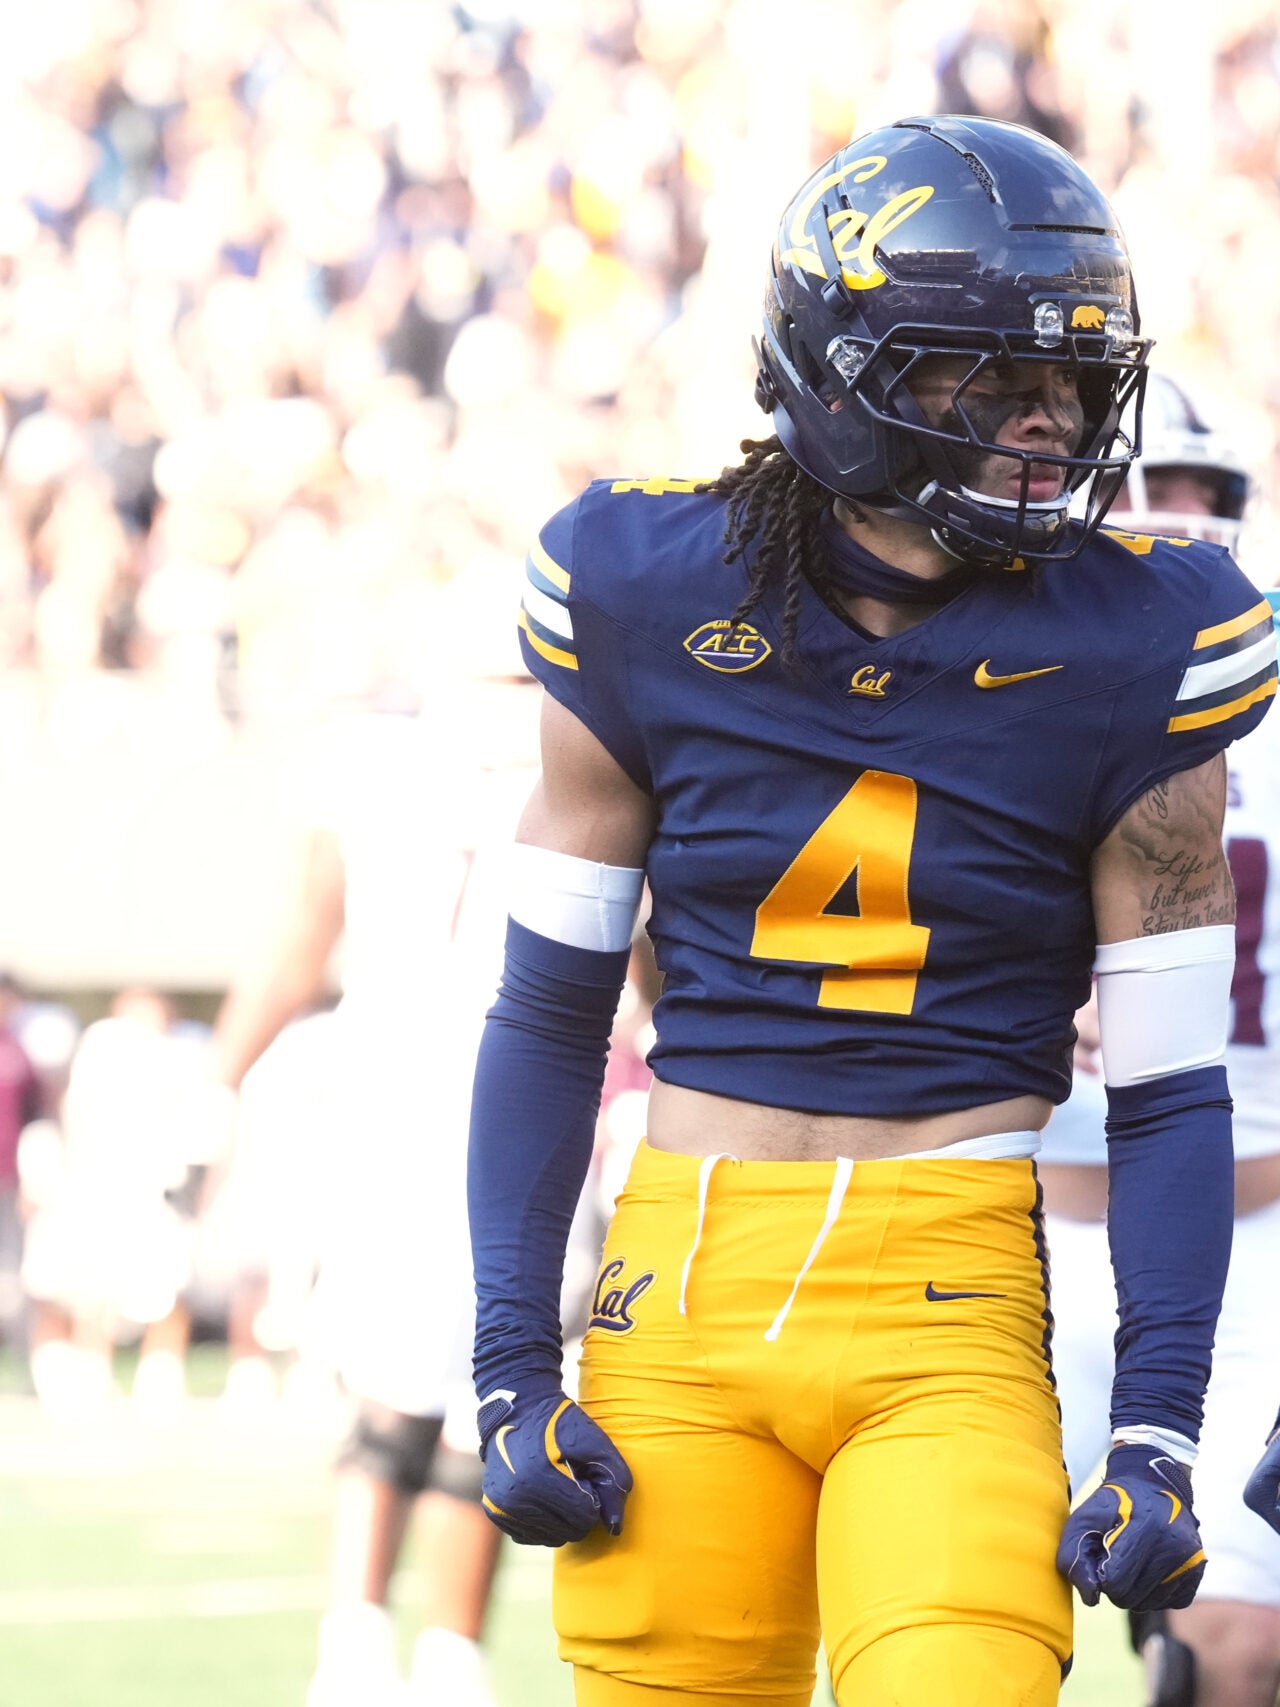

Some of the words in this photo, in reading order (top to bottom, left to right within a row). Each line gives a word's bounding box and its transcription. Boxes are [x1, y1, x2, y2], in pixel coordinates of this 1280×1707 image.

[780, 155, 935, 290] Cal
[848, 665, 891, 697] Cal
[750, 769, 931, 1015] 4
[1153, 848, 1204, 887] Life
[1150, 883, 1184, 911] but
[588, 1259, 654, 1332] Cal
